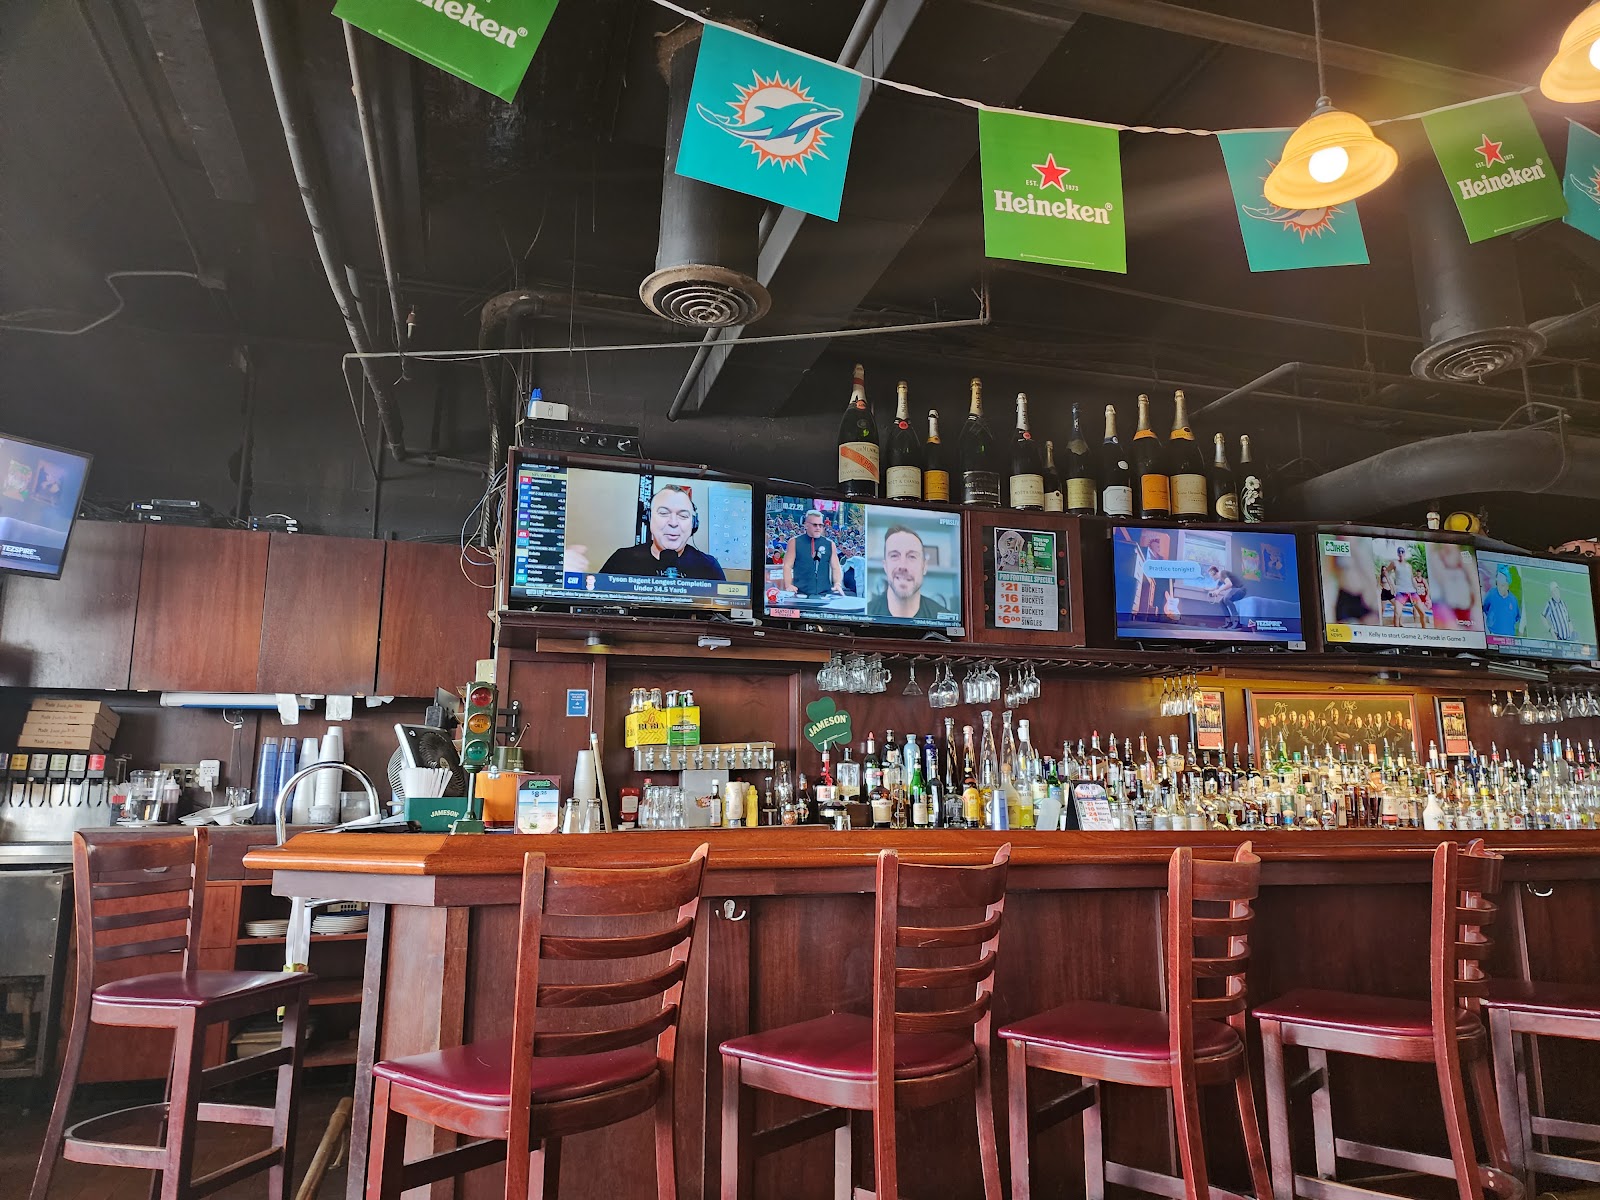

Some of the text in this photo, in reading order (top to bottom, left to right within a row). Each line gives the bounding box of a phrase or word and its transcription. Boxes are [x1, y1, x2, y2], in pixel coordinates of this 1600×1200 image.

[1457, 164, 1546, 200] Heineken
[994, 190, 1110, 224] Heineken
[652, 578, 676, 586] Longest
[677, 580, 712, 588] Completion
[1001, 582, 1044, 594] $21 BUCKETS
[1000, 594, 1044, 605] $16 BUCKETS
[999, 605, 1044, 616] $24 BUCKETS
[1021, 619, 1043, 627] SINGLES
[808, 715, 847, 738] JAMESON
[430, 810, 459, 818] JAMESON
